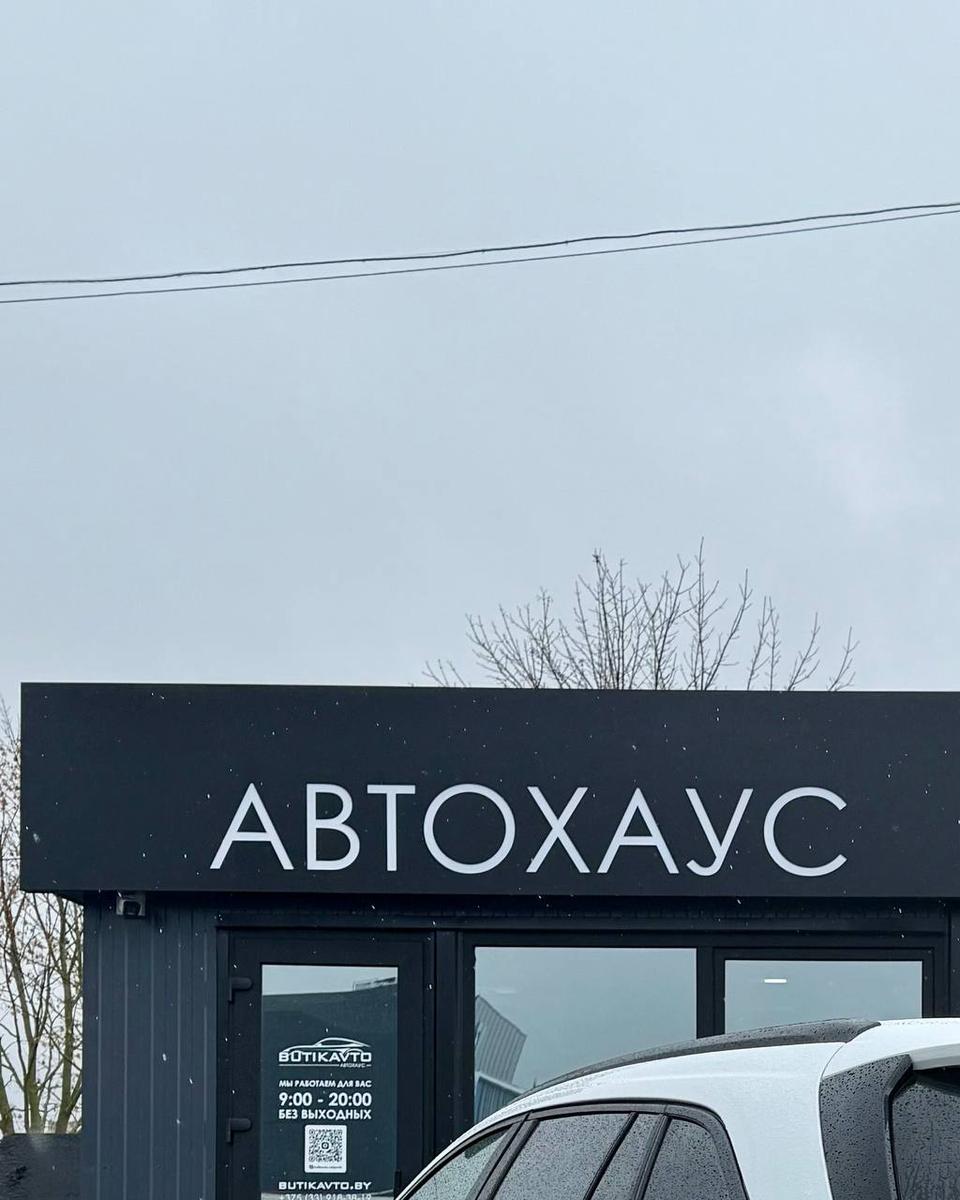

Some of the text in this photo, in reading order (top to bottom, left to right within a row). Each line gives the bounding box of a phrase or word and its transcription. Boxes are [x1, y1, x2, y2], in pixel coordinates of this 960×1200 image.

[209, 782, 848, 877] АВТОХАУС
[279, 1051, 372, 1062] BUTIKAVTO
[279, 1080, 372, 1088] МЫ РАБОТАЕМ ДЛЯ ВАС
[279, 1092, 313, 1107] 9:00
[328, 1092, 372, 1107] 20:00
[279, 1109, 372, 1120] БЕЗ ВЫХОДНЫХ
[279, 1181, 372, 1190] BUTIKAVTO.BY
